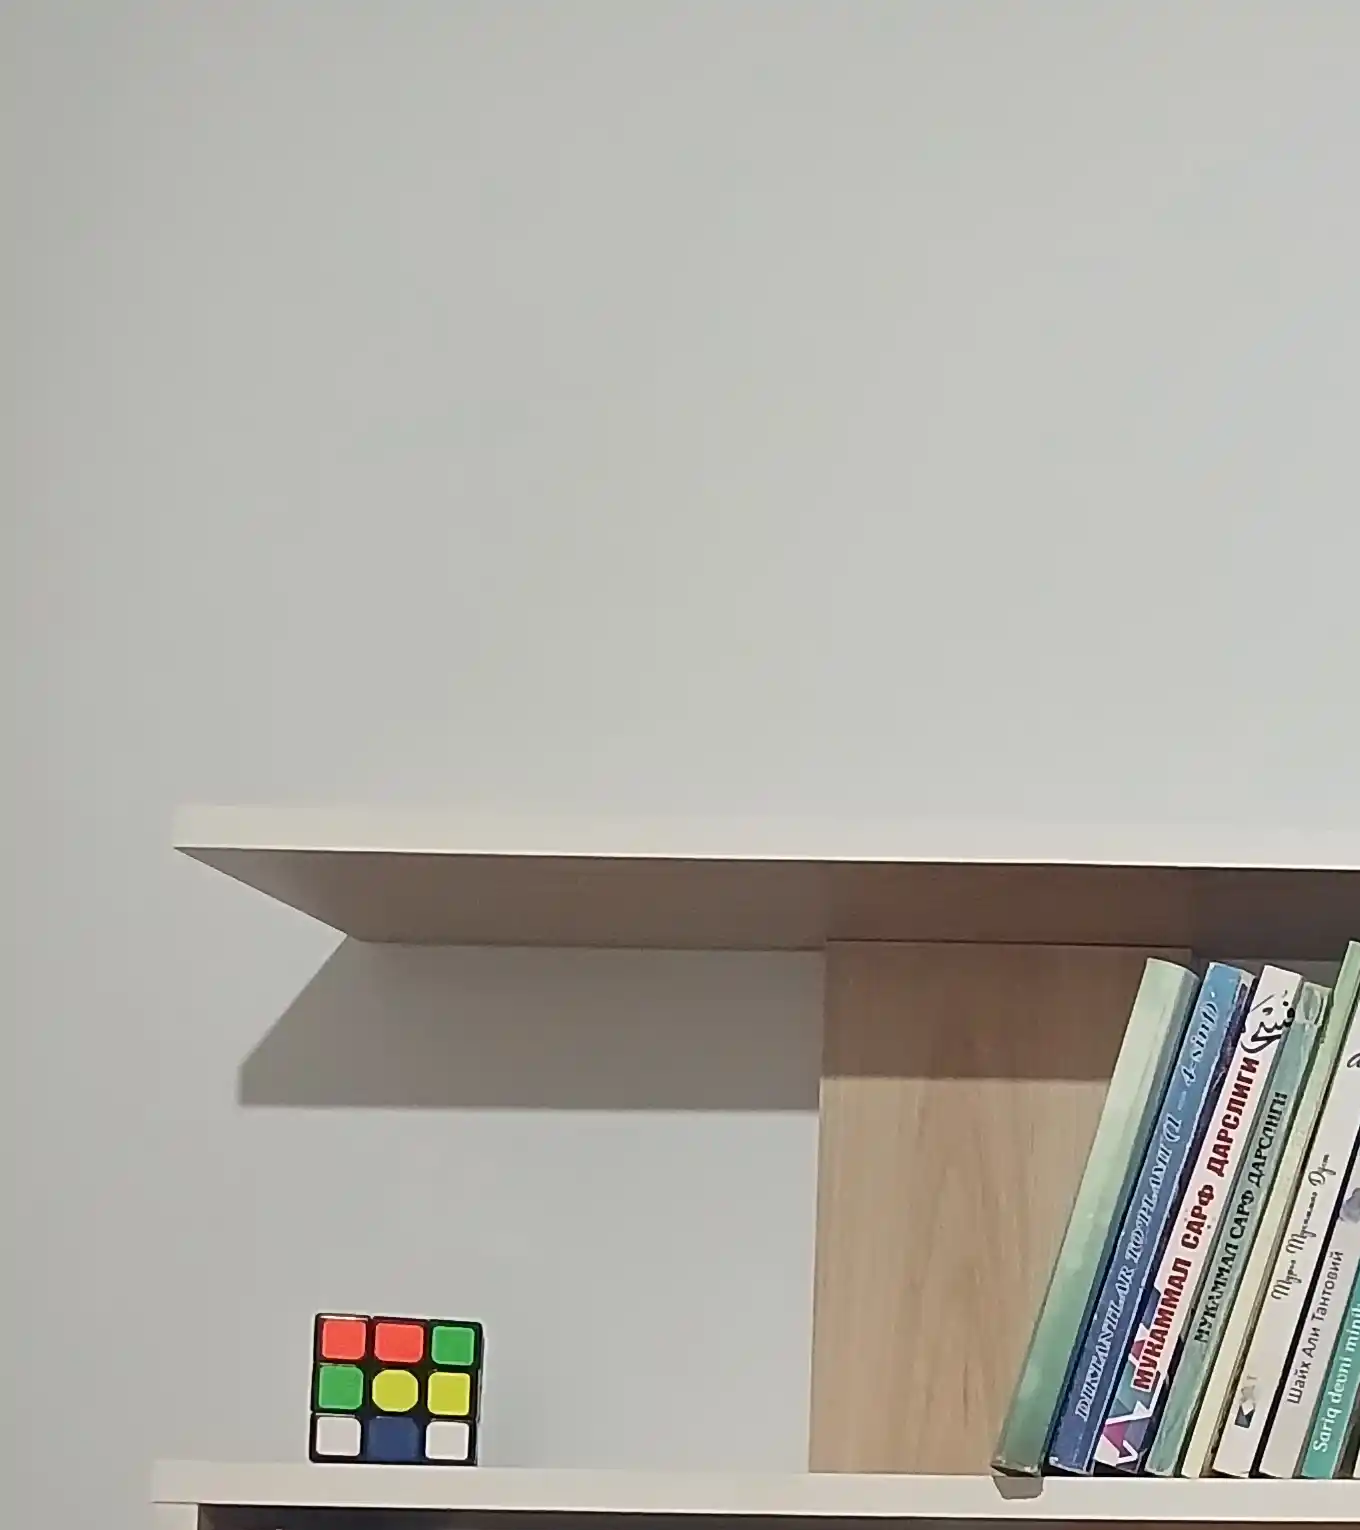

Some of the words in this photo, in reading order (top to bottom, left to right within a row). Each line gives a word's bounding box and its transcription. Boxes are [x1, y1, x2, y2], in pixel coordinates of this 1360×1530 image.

[1132, 1256, 1193, 1391] МУКАММАЛ
[1181, 1184, 1216, 1250] САРФ
[1206, 1056, 1261, 1178] ДАРСЛИГИ
[1194, 1242, 1241, 1343] МУКАММАЛ
[1229, 1189, 1256, 1240] САРФ
[1248, 1091, 1289, 1188] ДАРСЛИГИ
[1076, 1266, 1135, 1421] DIKTANTLAR
[1287, 1359, 1312, 1405] Шайх
[1301, 1321, 1321, 1359] Али
[1311, 1250, 1345, 1322] Тантовий
[1312, 1405, 1338, 1453] Sariq
[1331, 1355, 1353, 1404] devni
